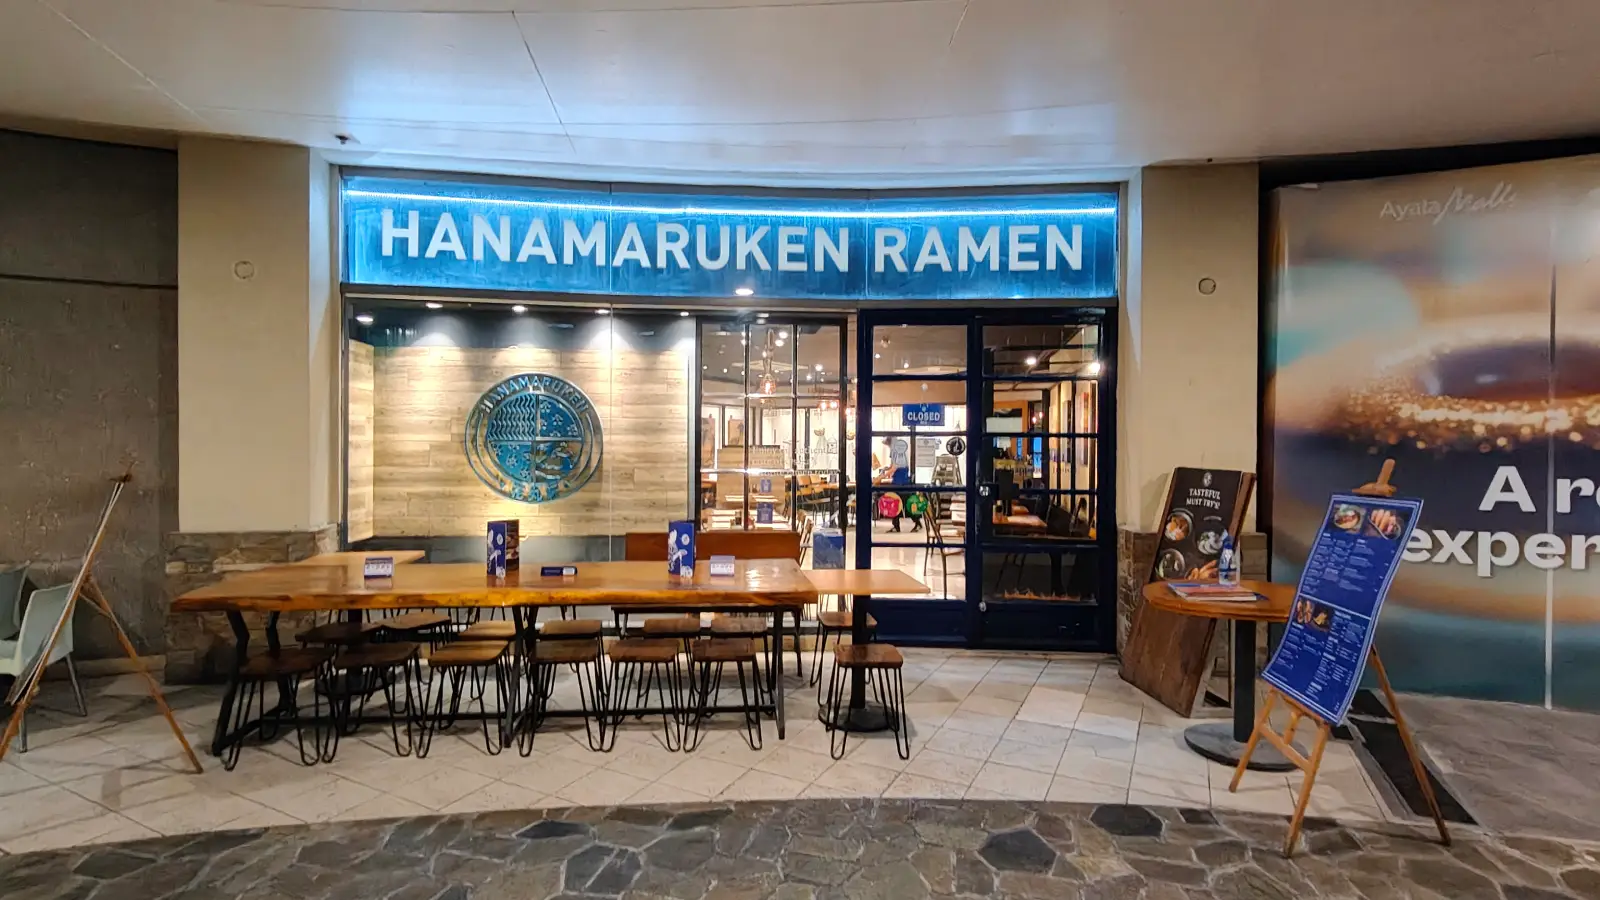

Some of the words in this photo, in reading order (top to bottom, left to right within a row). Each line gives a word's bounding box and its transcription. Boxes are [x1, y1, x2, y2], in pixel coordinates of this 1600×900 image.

[1379, 199, 1441, 221] Ayala
[381, 208, 849, 273] HANAMARUKEN
[874, 225, 1083, 273] RAMEN
[907, 411, 940, 421] CLOSED
[1189, 488, 1220, 499] TASTEFUL
[1478, 465, 1537, 512] A
[1556, 478, 1600, 513] r
[1186, 498, 1202, 506] MUST
